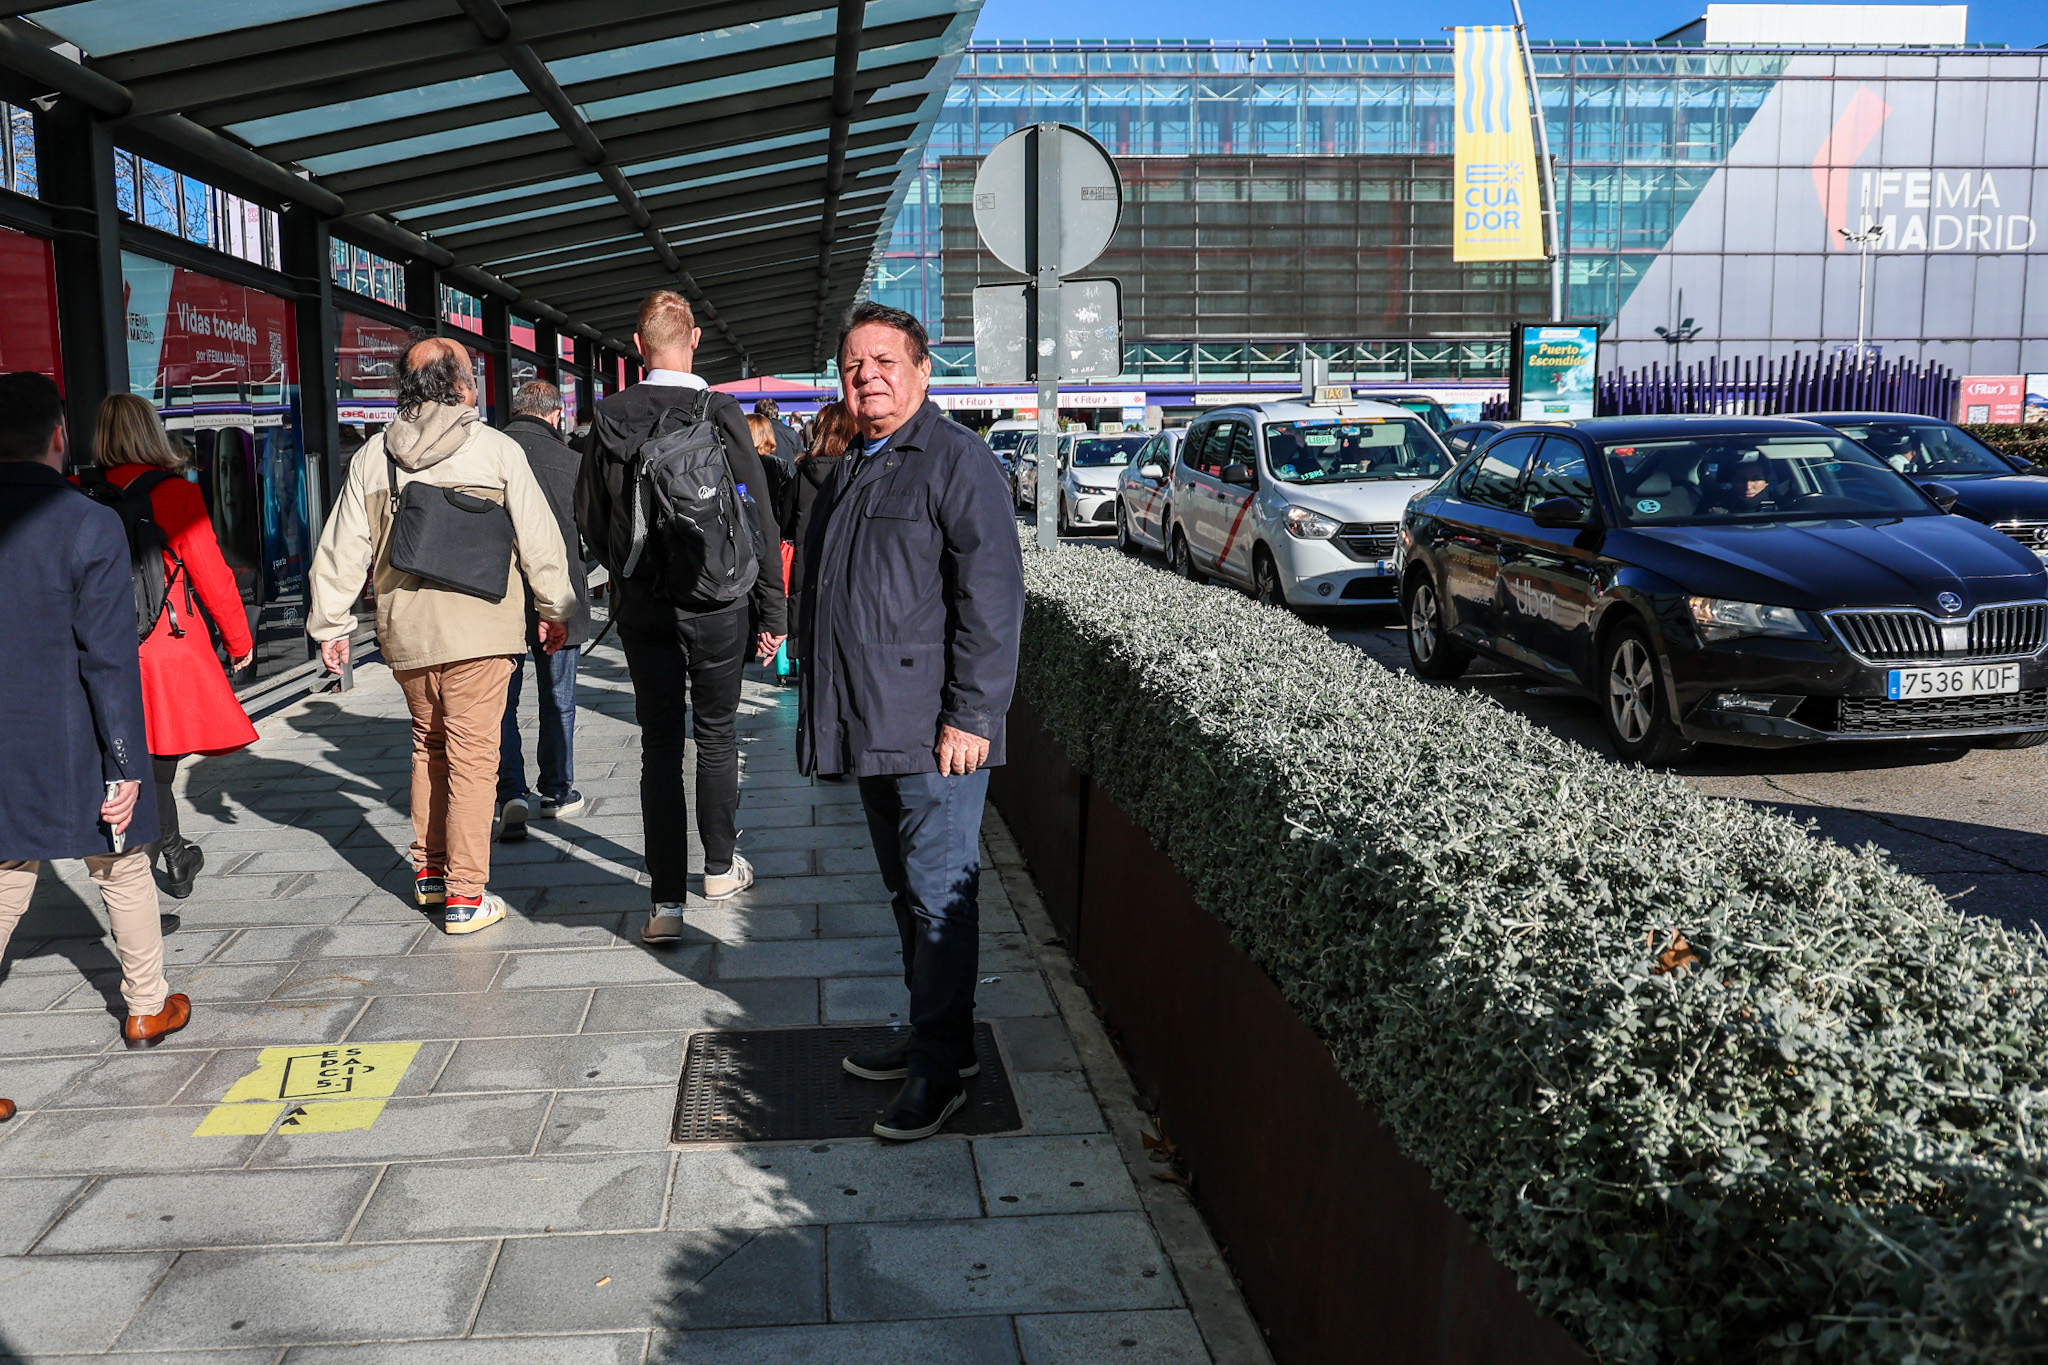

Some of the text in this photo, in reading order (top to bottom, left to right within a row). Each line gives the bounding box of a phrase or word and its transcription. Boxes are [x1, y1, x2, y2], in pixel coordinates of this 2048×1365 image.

[1465, 187, 1521, 207] CUA
[1861, 171, 2001, 208] IFEMA
[1465, 210, 1521, 231] DOR
[1858, 214, 2037, 250] MADRID
[128, 312, 149, 328] IFEMA
[176, 301, 258, 346] Vidas tocadas
[130, 328, 155, 345] MADRID
[1539, 343, 1580, 355] Puerto
[196, 349, 246, 367] por IFEMA MADRID
[1528, 354, 1588, 367] Escondido
[1324, 387, 1344, 399] TAXI
[1975, 383, 1999, 394] Fitur
[966, 397, 988, 406] Fitur
[1081, 395, 1101, 404] Fitur
[1308, 436, 1333, 444] LIBRE
[1515, 578, 1557, 620] Uber
[1905, 667, 2013, 695] 7536 KDF
